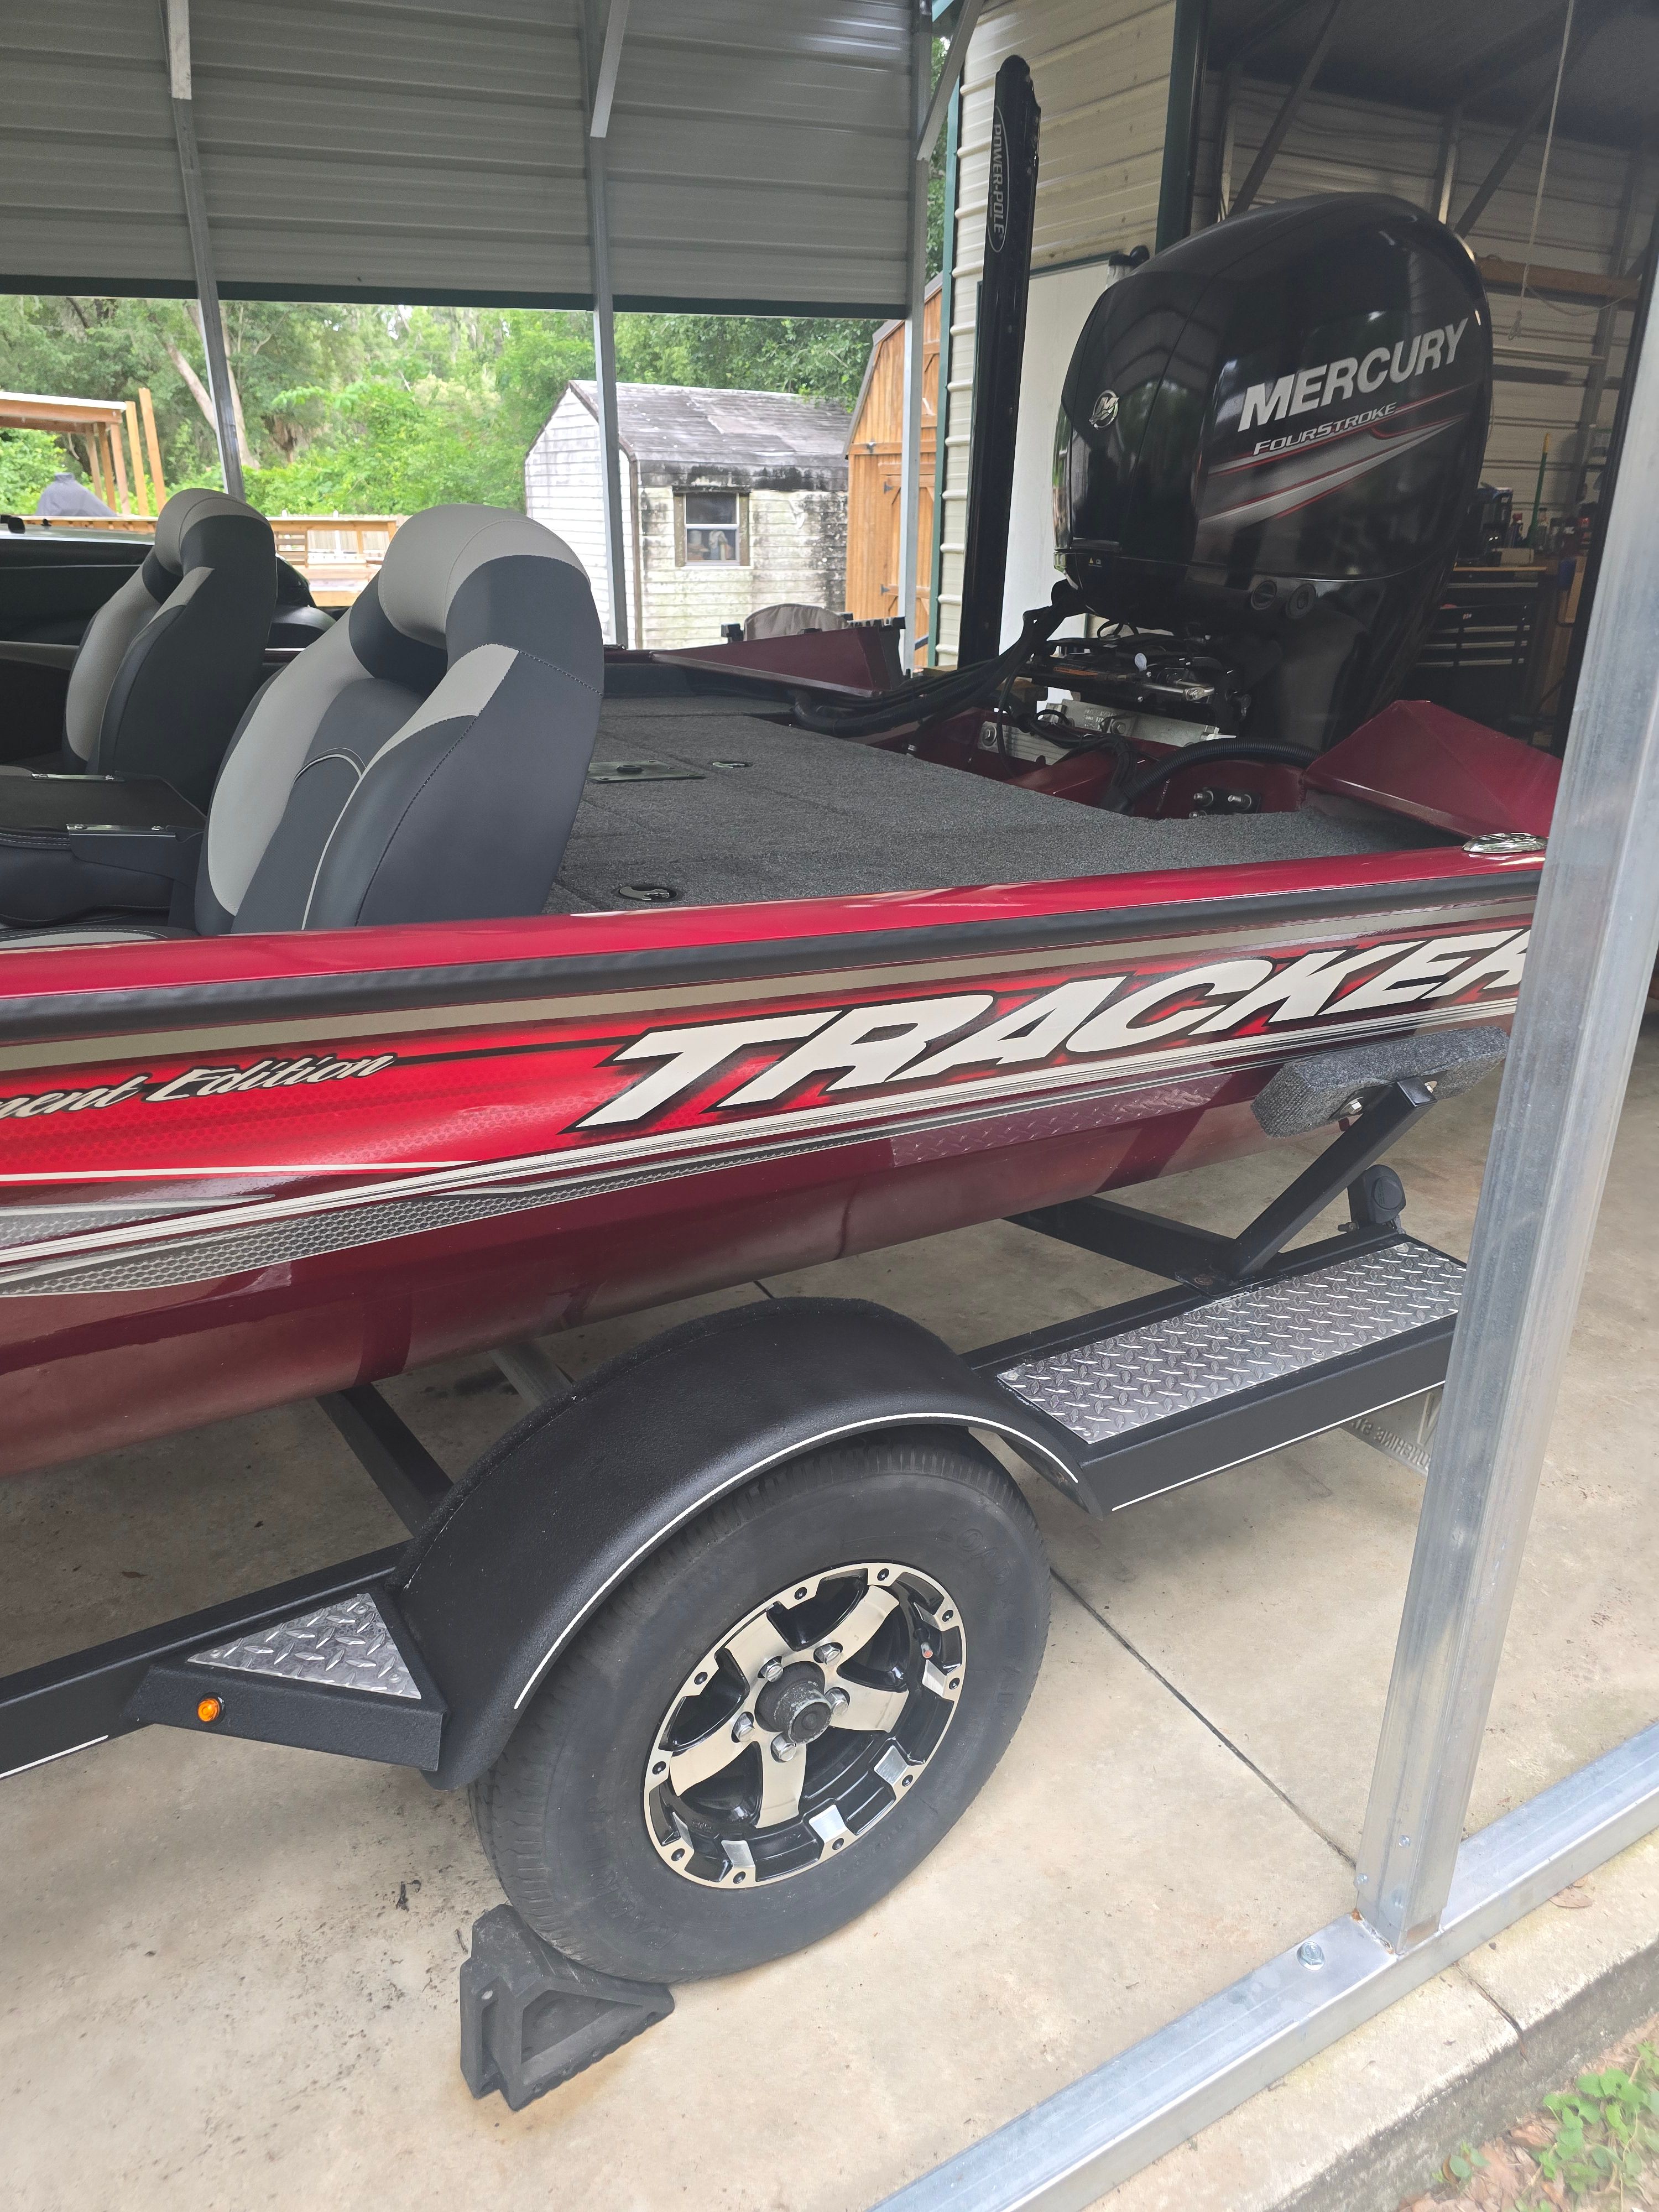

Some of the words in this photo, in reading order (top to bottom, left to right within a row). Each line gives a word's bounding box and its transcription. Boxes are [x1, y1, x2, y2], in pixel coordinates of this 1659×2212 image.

[994, 124, 1004, 235] POWER-POLE
[1239, 319, 1468, 432] MERCURY
[1254, 403, 1396, 456] FOURSTROKE
[147, 1056, 394, 1101] Edition
[576, 929, 1531, 1128] TRACKER
